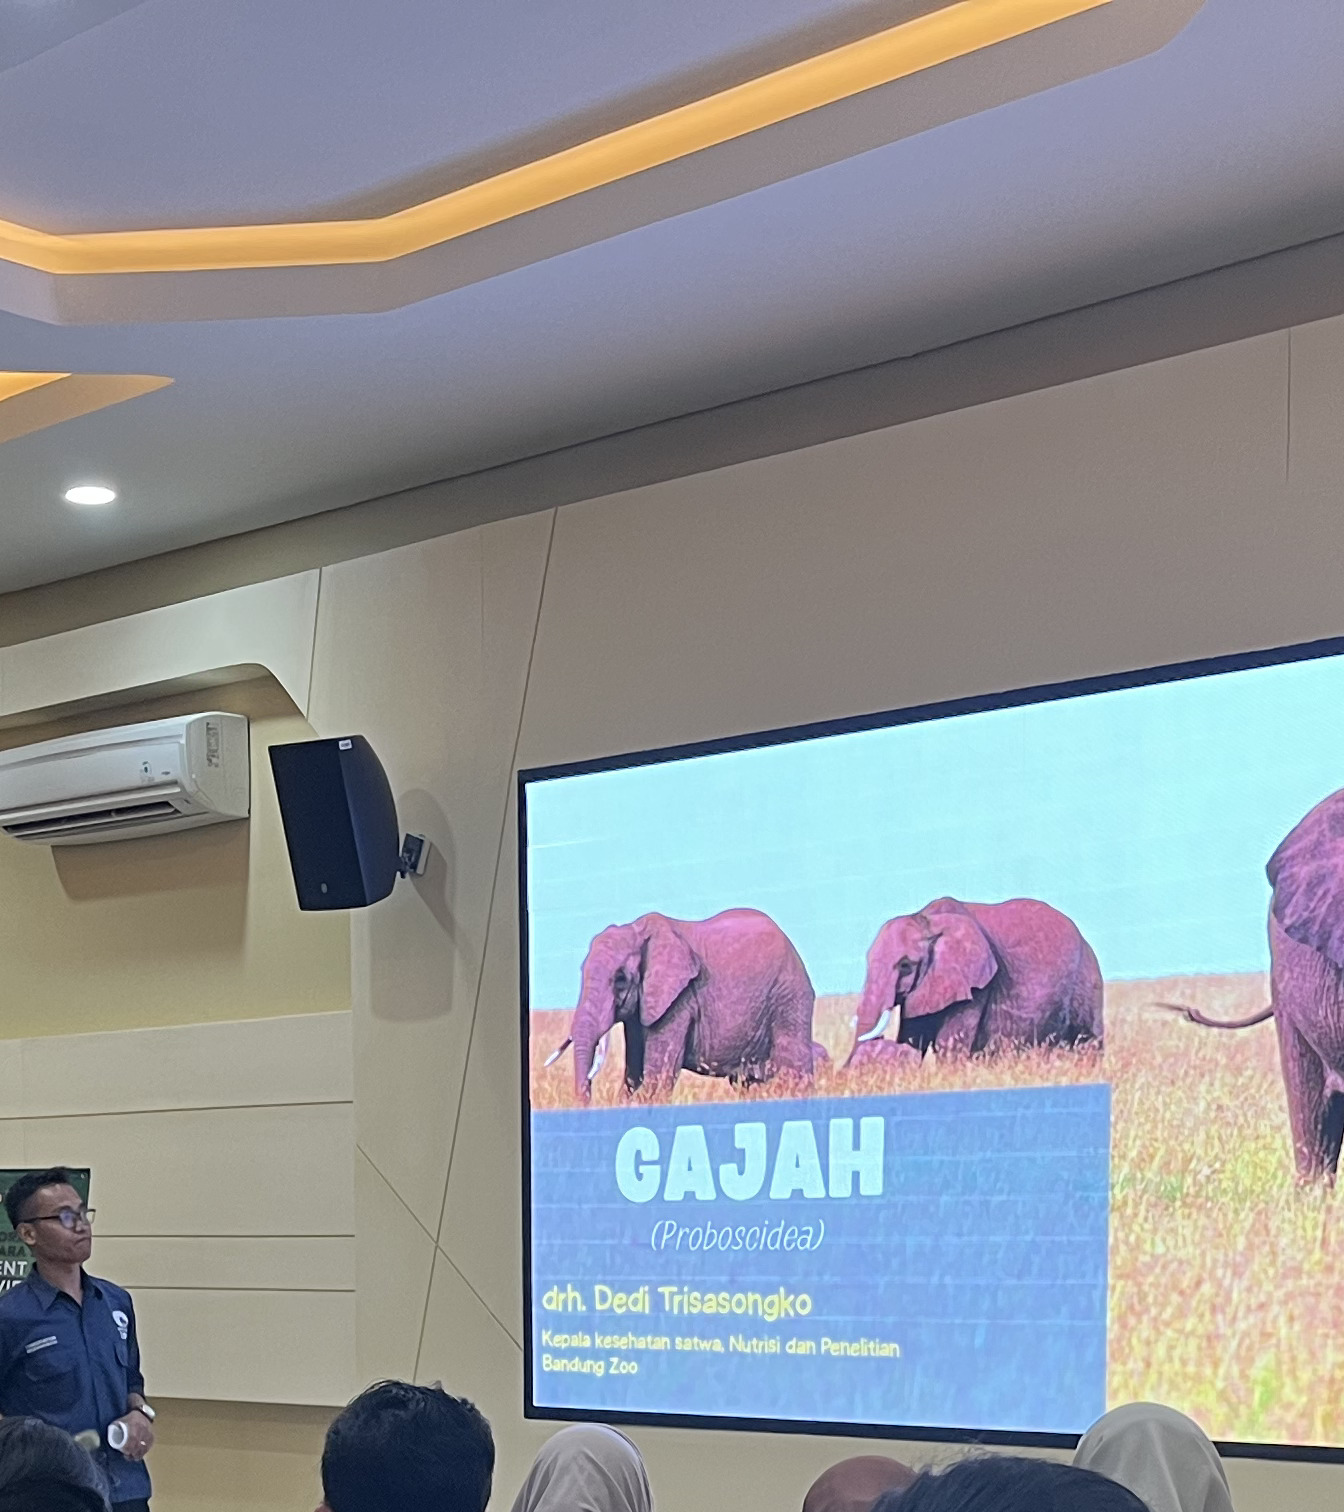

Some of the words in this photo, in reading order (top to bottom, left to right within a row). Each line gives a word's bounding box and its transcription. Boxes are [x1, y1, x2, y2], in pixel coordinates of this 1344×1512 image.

[615, 1116, 885, 1203] GAJAH
[650, 1219, 825, 1253] (Proboscidea)
[542, 1284, 587, 1312] drh.
[594, 1285, 650, 1314] Dedi
[657, 1286, 813, 1322] Trisasongko
[542, 1329, 591, 1349] Kepala
[595, 1331, 671, 1351] kesehatan
[729, 1335, 781, 1355] Nutrisi
[786, 1338, 816, 1356] dan
[821, 1337, 900, 1358] Penelitian
[542, 1356, 605, 1377] Bandung
[609, 1357, 638, 1375] Zoo
